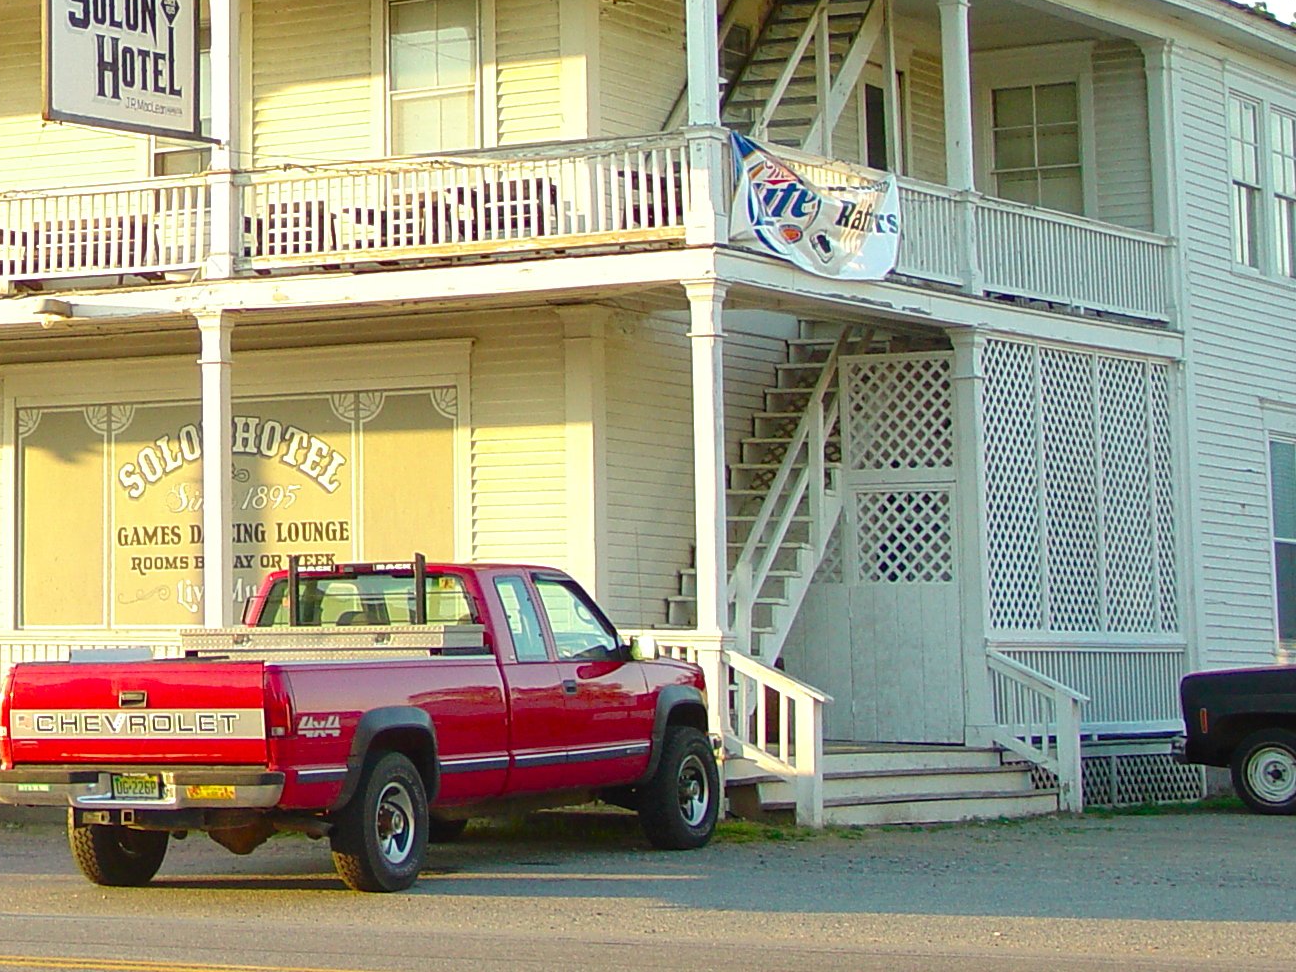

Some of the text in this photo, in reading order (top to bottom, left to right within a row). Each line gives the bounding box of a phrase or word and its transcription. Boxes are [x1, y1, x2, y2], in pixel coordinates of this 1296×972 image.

[95, 26, 182, 100] HOTEL
[118, 415, 347, 499] SOLO HOTEL
[241, 484, 302, 510] 1895
[117, 525, 182, 546] GAMES
[276, 521, 350, 543] LOUNGE
[131, 556, 189, 575] ROOMS
[260, 554, 282, 570] OR
[177, 578, 204, 613] Liv
[34, 712, 240, 736] CHEVROLET
[297, 715, 342, 738] 4x4
